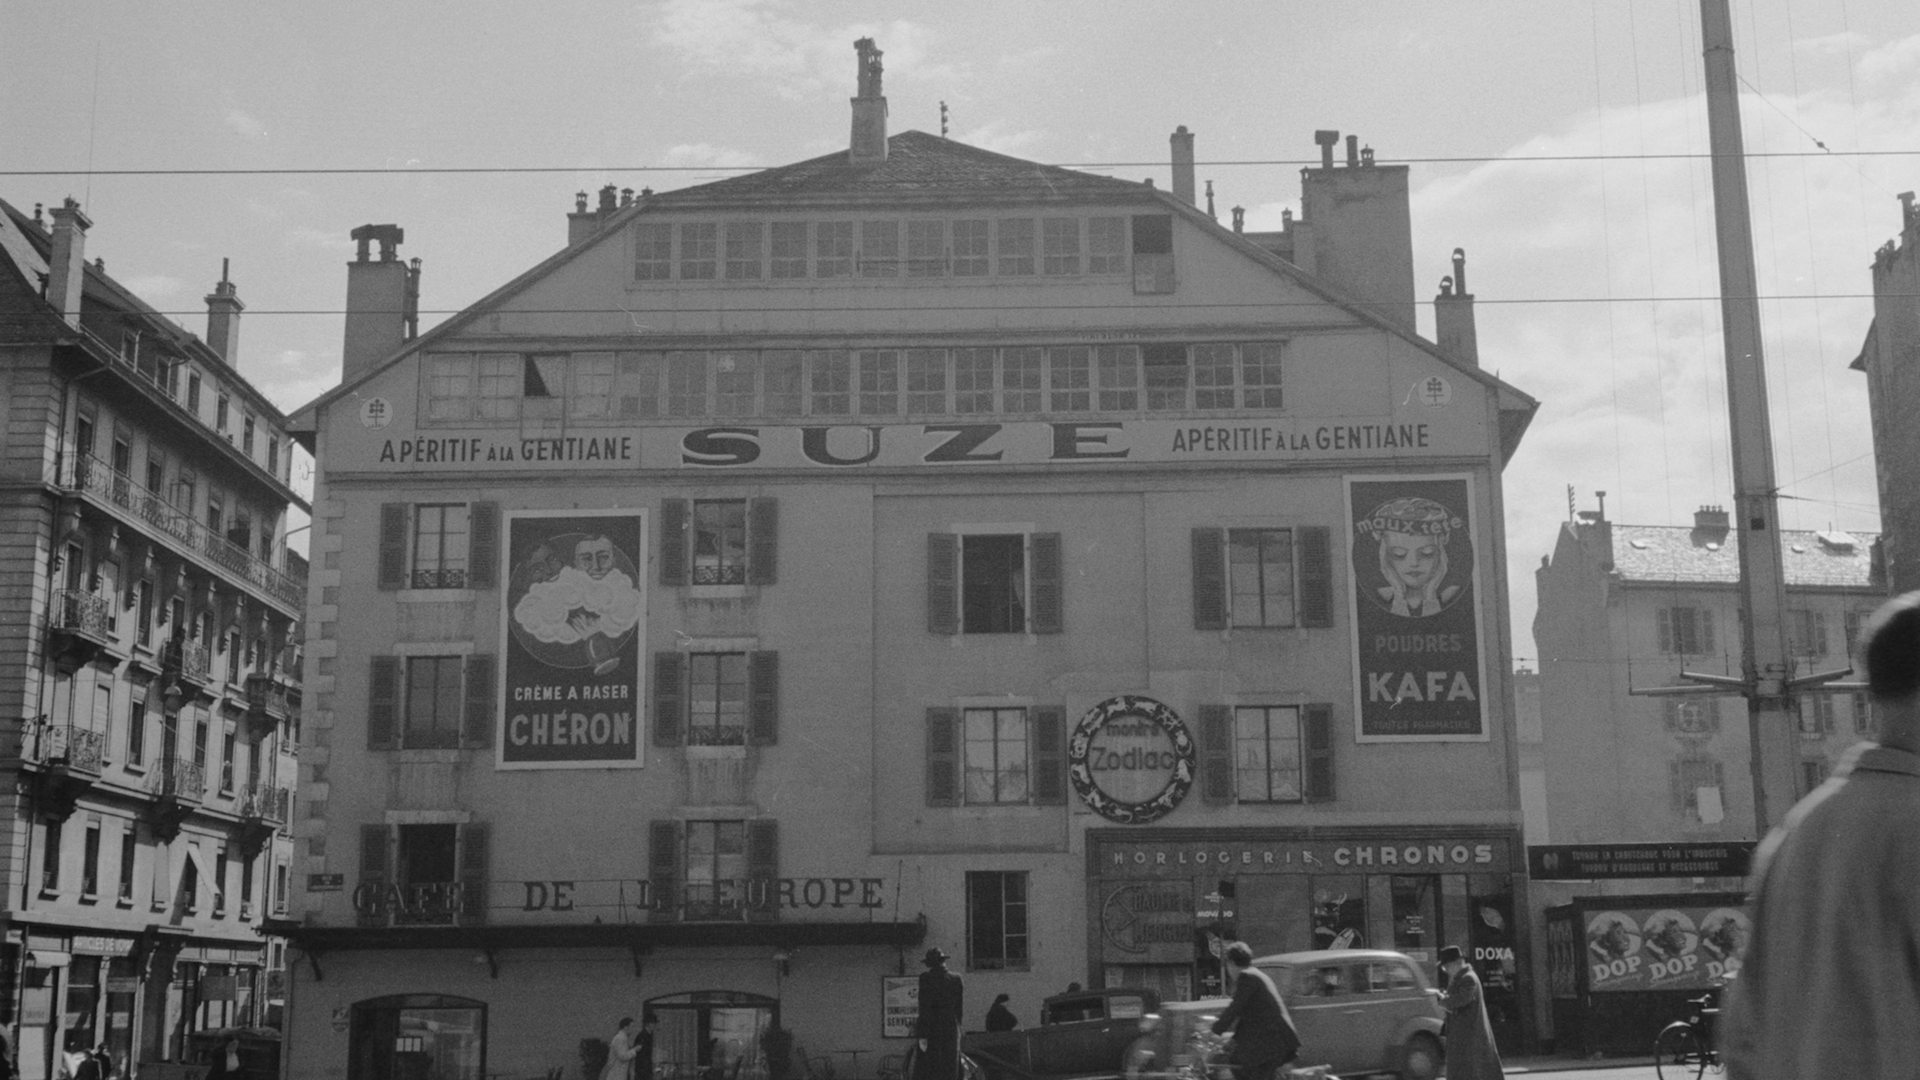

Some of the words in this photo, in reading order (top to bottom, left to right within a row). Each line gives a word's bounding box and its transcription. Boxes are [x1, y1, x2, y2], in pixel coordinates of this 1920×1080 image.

[379, 435, 481, 463] APÉRITIF
[499, 446, 514, 461] LA
[521, 437, 631, 461] GENTIANE
[682, 422, 1131, 467] SUZE
[1172, 425, 1272, 452] APÉRITIF
[1291, 434, 1310, 450] LA
[1316, 424, 1429, 450] GENTIANE
[1356, 517, 1415, 534] maux
[1375, 634, 1462, 653] POUDRES
[514, 684, 562, 701] CRÈME
[567, 686, 578, 700] A
[583, 685, 628, 699] RASER
[1368, 671, 1476, 702] KAFA
[510, 709, 630, 746] CHÉRON
[1091, 747, 1175, 771] Zodiac
[1114, 850, 1313, 865] HORLOGERIE
[1334, 844, 1493, 866] CHRONOS
[522, 881, 574, 912] DE
[1475, 947, 1514, 961] DOXA
[1593, 956, 1641, 981] DOP
[1648, 954, 1698, 980] DOP
